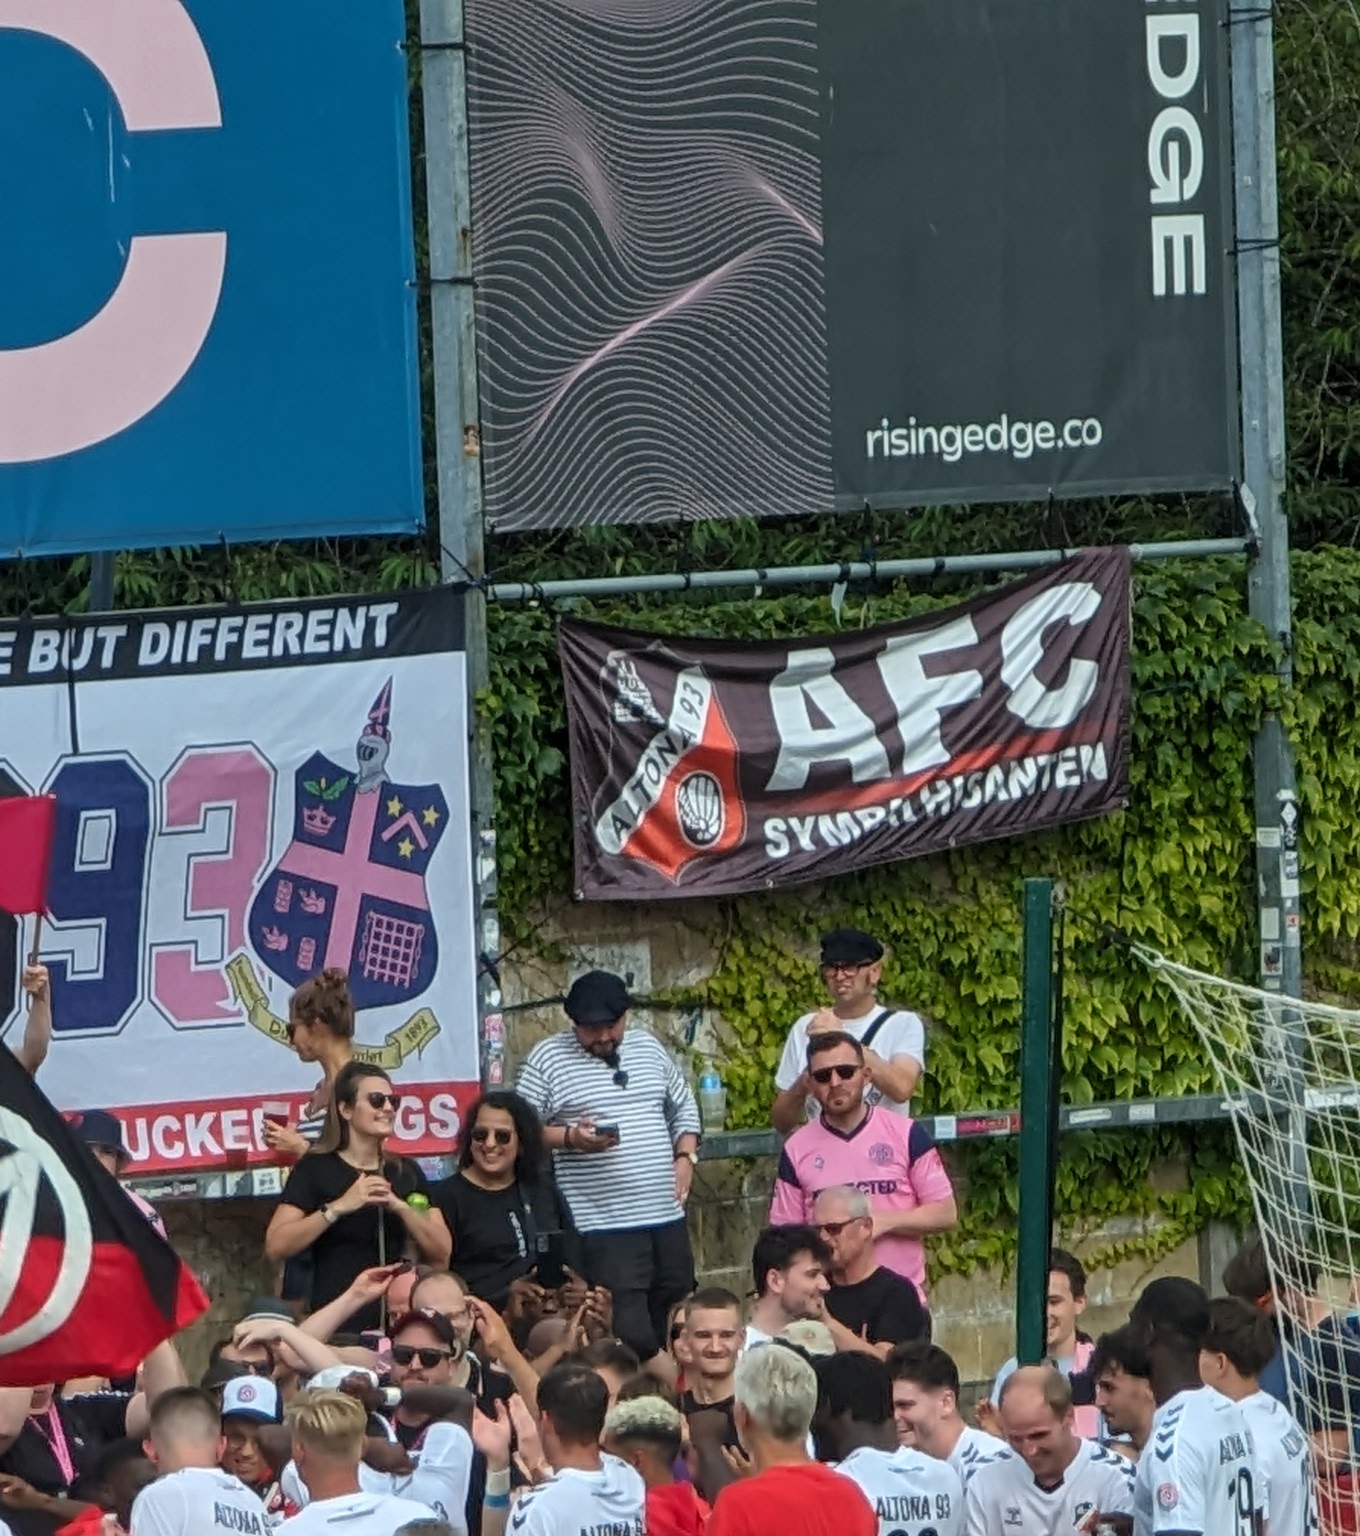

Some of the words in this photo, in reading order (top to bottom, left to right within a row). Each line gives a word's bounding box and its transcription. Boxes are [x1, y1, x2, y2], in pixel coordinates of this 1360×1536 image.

[1145, 0, 1206, 296] DGE
[866, 414, 1103, 462] risingedge.co
[26, 625, 128, 673] BUT
[137, 603, 400, 665] DIFFERENT
[765, 582, 1103, 792] AFC
[611, 724, 697, 841] ALTONA
[679, 681, 704, 721] 93
[213, 1501, 262, 1536] ALTONA
[875, 1495, 931, 1520] ALTONA
